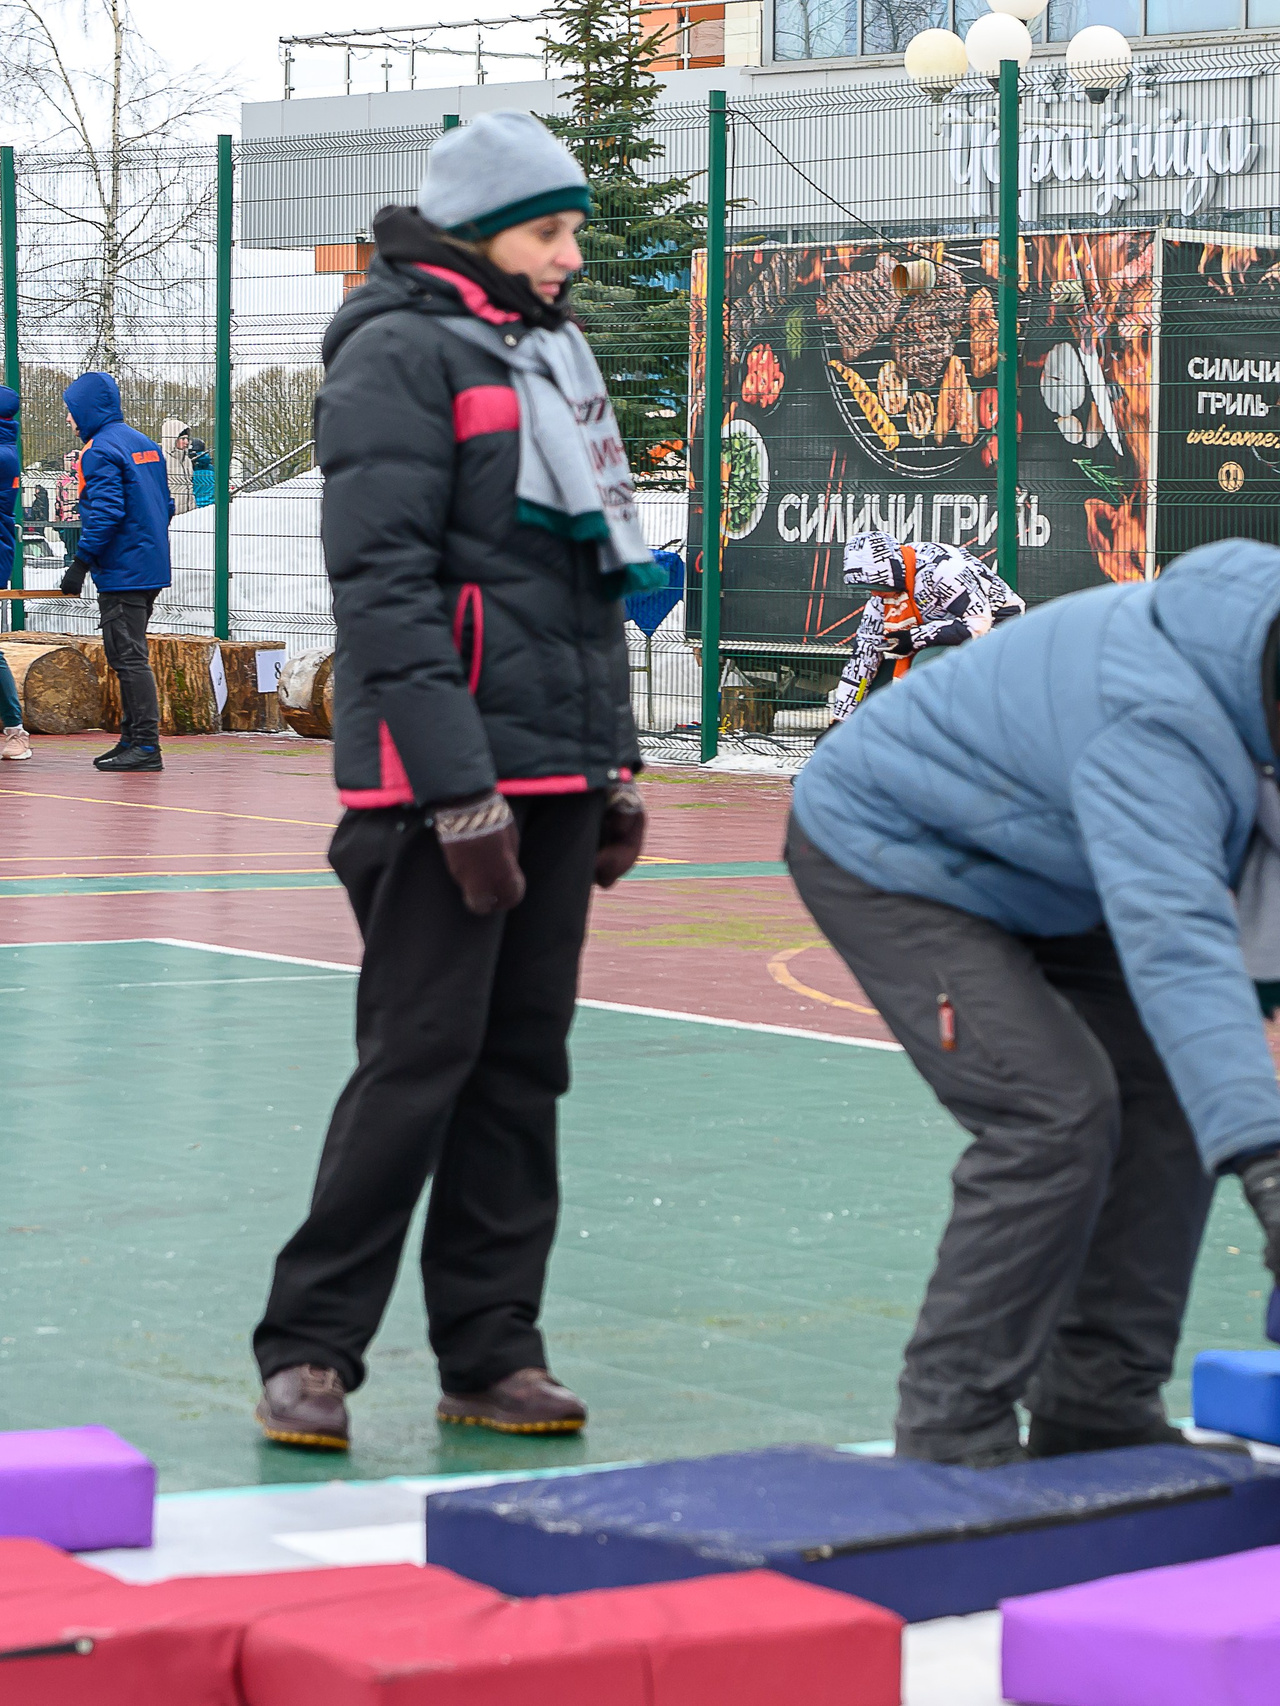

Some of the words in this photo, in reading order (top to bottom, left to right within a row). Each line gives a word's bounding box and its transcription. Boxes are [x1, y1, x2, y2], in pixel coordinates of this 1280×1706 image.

[1187, 357, 1280, 383] СИЛИЧИ
[1197, 391, 1269, 417] ГРИЛЬ
[777, 493, 923, 544] СИЛИЧИ
